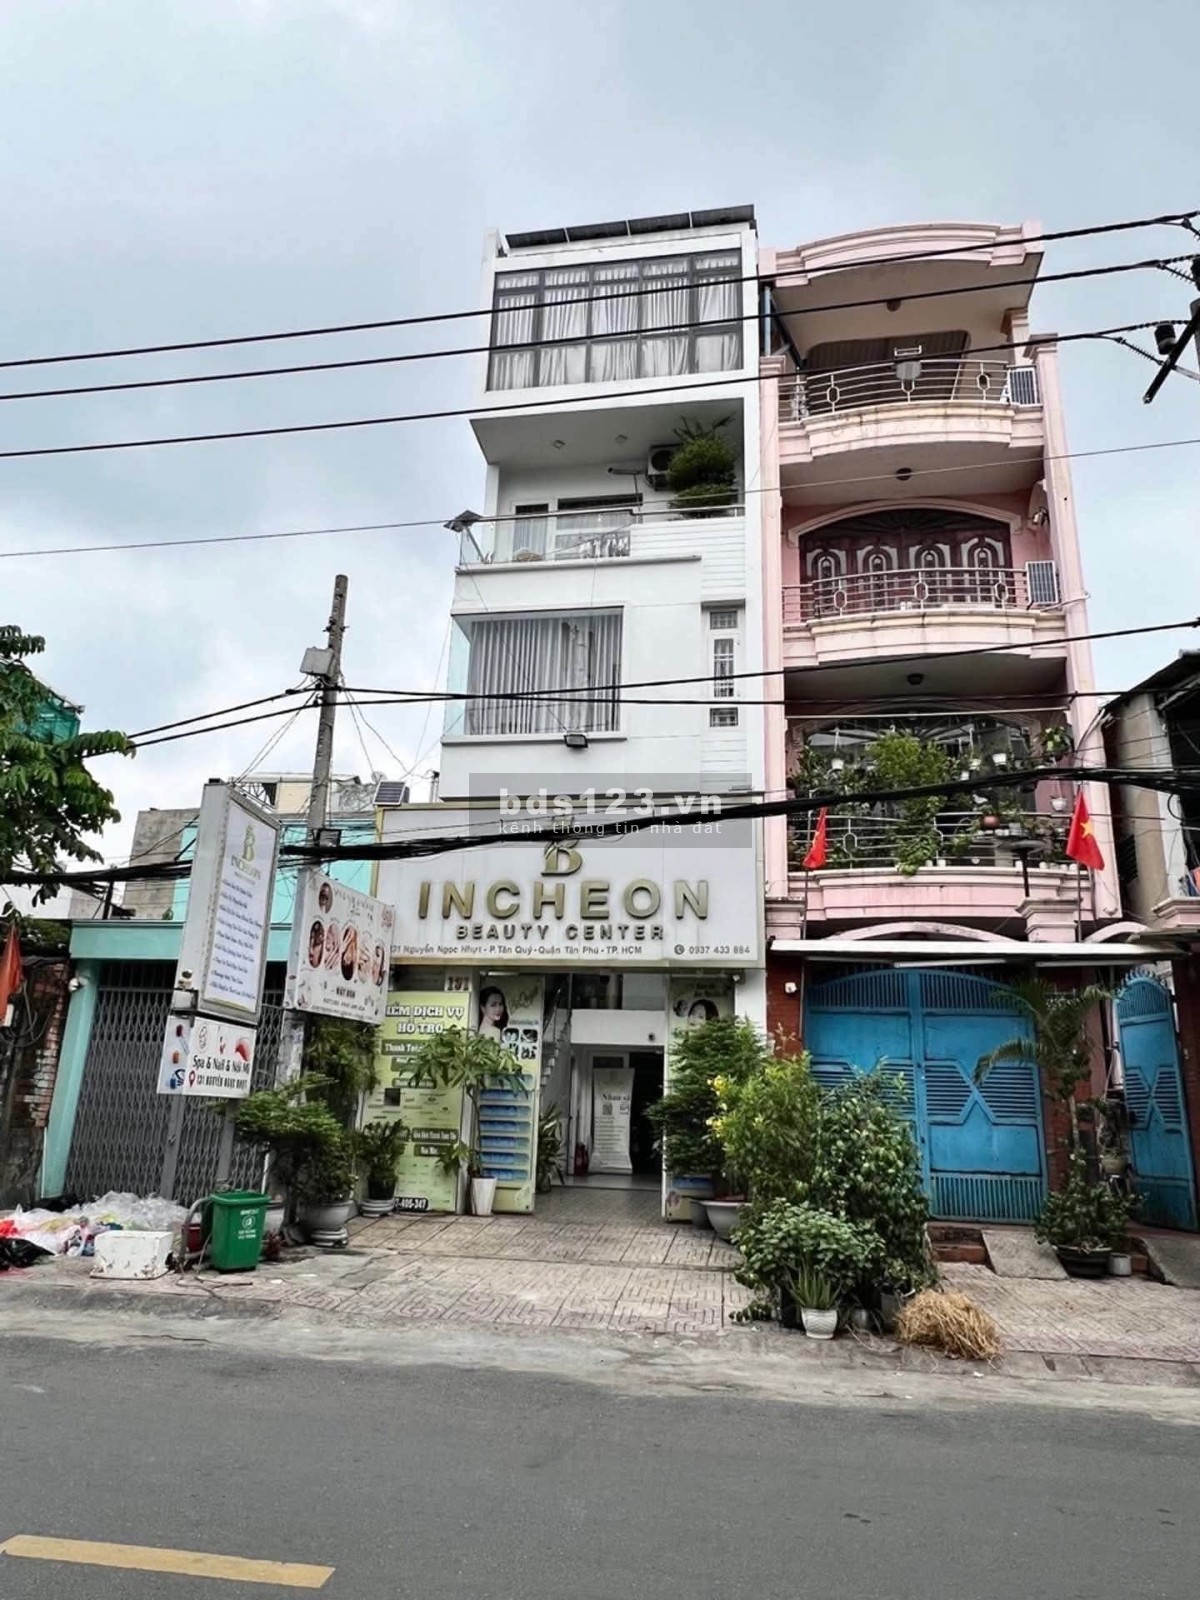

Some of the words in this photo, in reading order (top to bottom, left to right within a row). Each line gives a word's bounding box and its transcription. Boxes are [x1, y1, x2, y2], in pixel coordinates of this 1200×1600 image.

[418, 879, 709, 920] INCHEON
[456, 924, 549, 940] BEAUTY
[565, 924, 664, 941] CENTER
[193, 1054, 205, 1070] Spa
